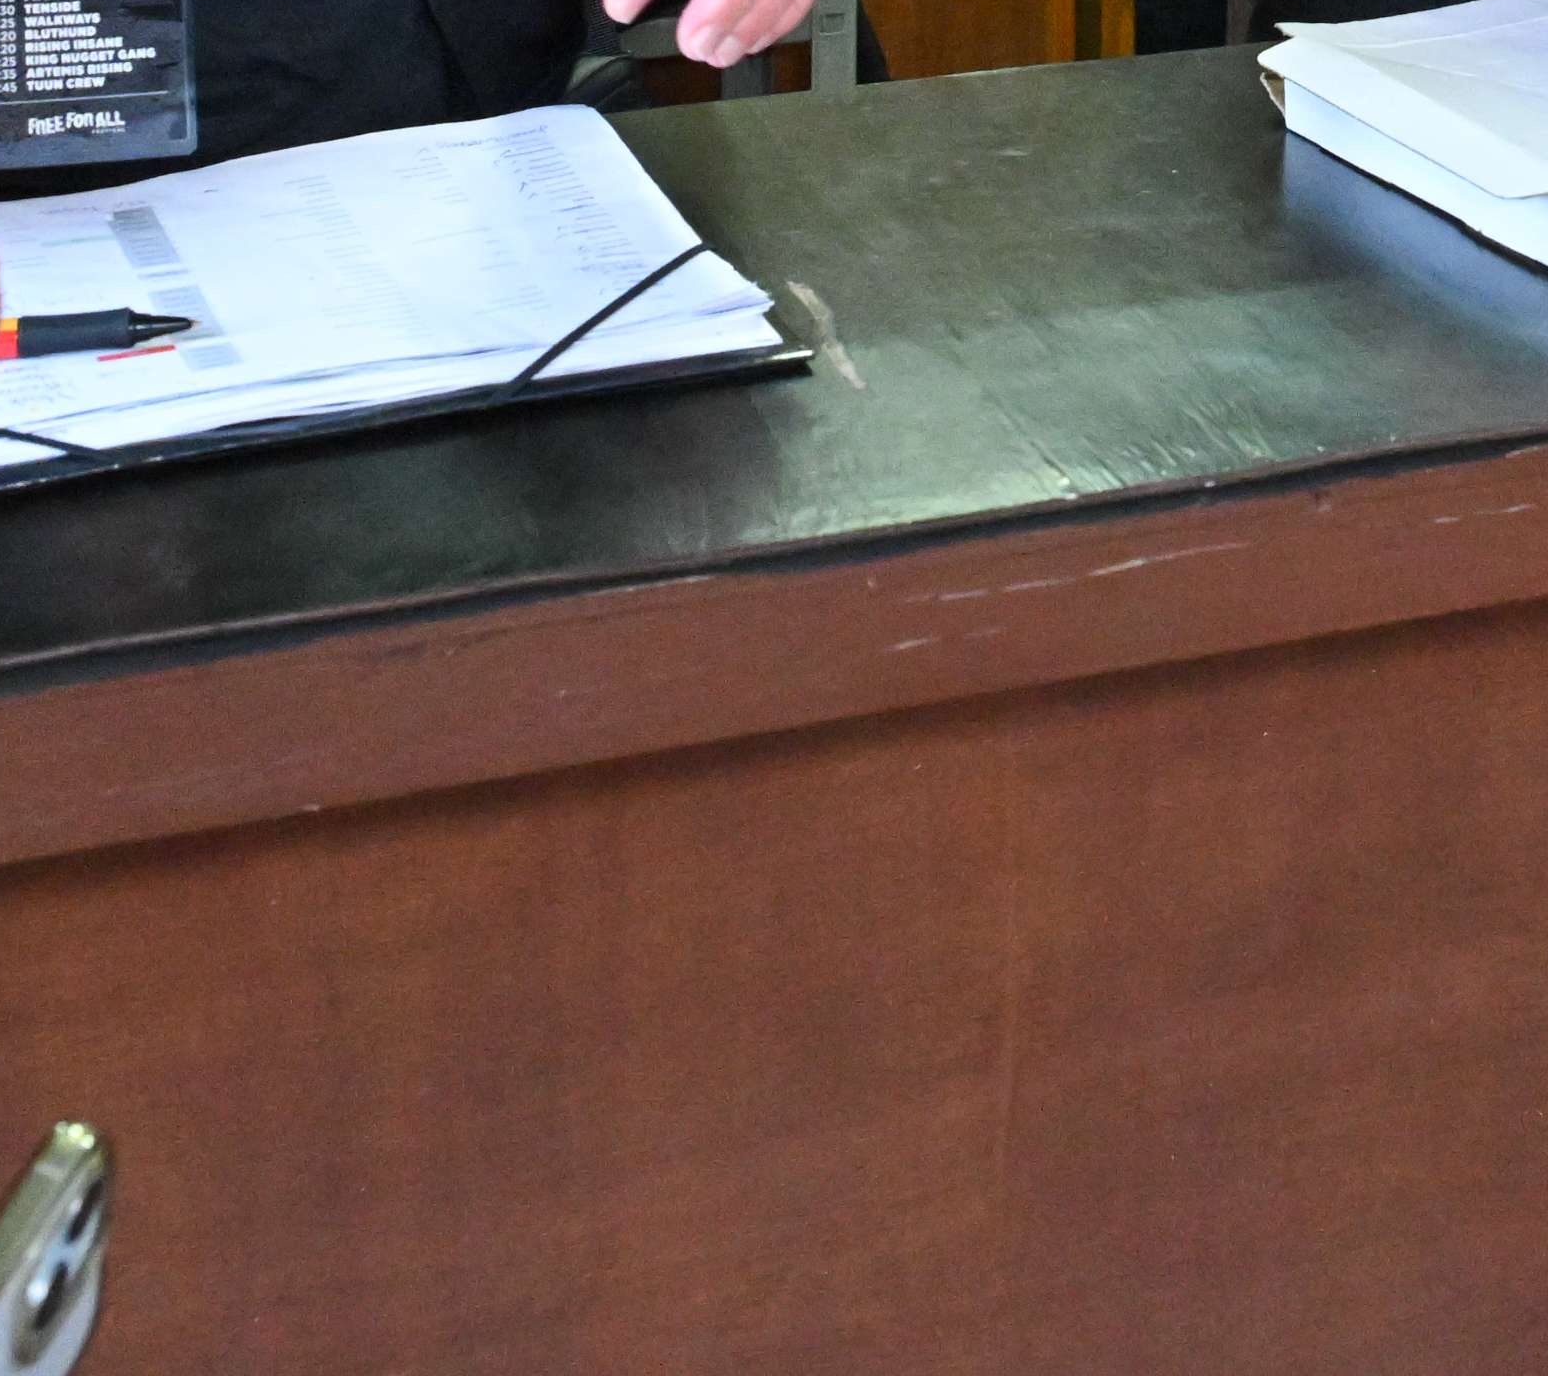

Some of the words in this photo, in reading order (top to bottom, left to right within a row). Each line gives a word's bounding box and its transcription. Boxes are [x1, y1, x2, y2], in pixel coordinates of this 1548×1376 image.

[23, 1, 81, 14] TENSIDE
[24, 13, 101, 28] WALKWAYS
[24, 26, 97, 40] BLUTHUND
[25, 40, 70, 53] RISING
[73, 37, 123, 50] INSANE
[25, 54, 59, 66] KING
[61, 50, 115, 64] NUGGET
[118, 47, 156, 60] GANG
[26, 65, 85, 79] ARTEMIS
[87, 62, 133, 75] RISING
[26, 79, 63, 92] TUUN
[66, 76, 106, 89] CREW
[28, 115, 65, 136] FREE
[66, 111, 93, 129] FOR
[95, 110, 125, 128] ALL
